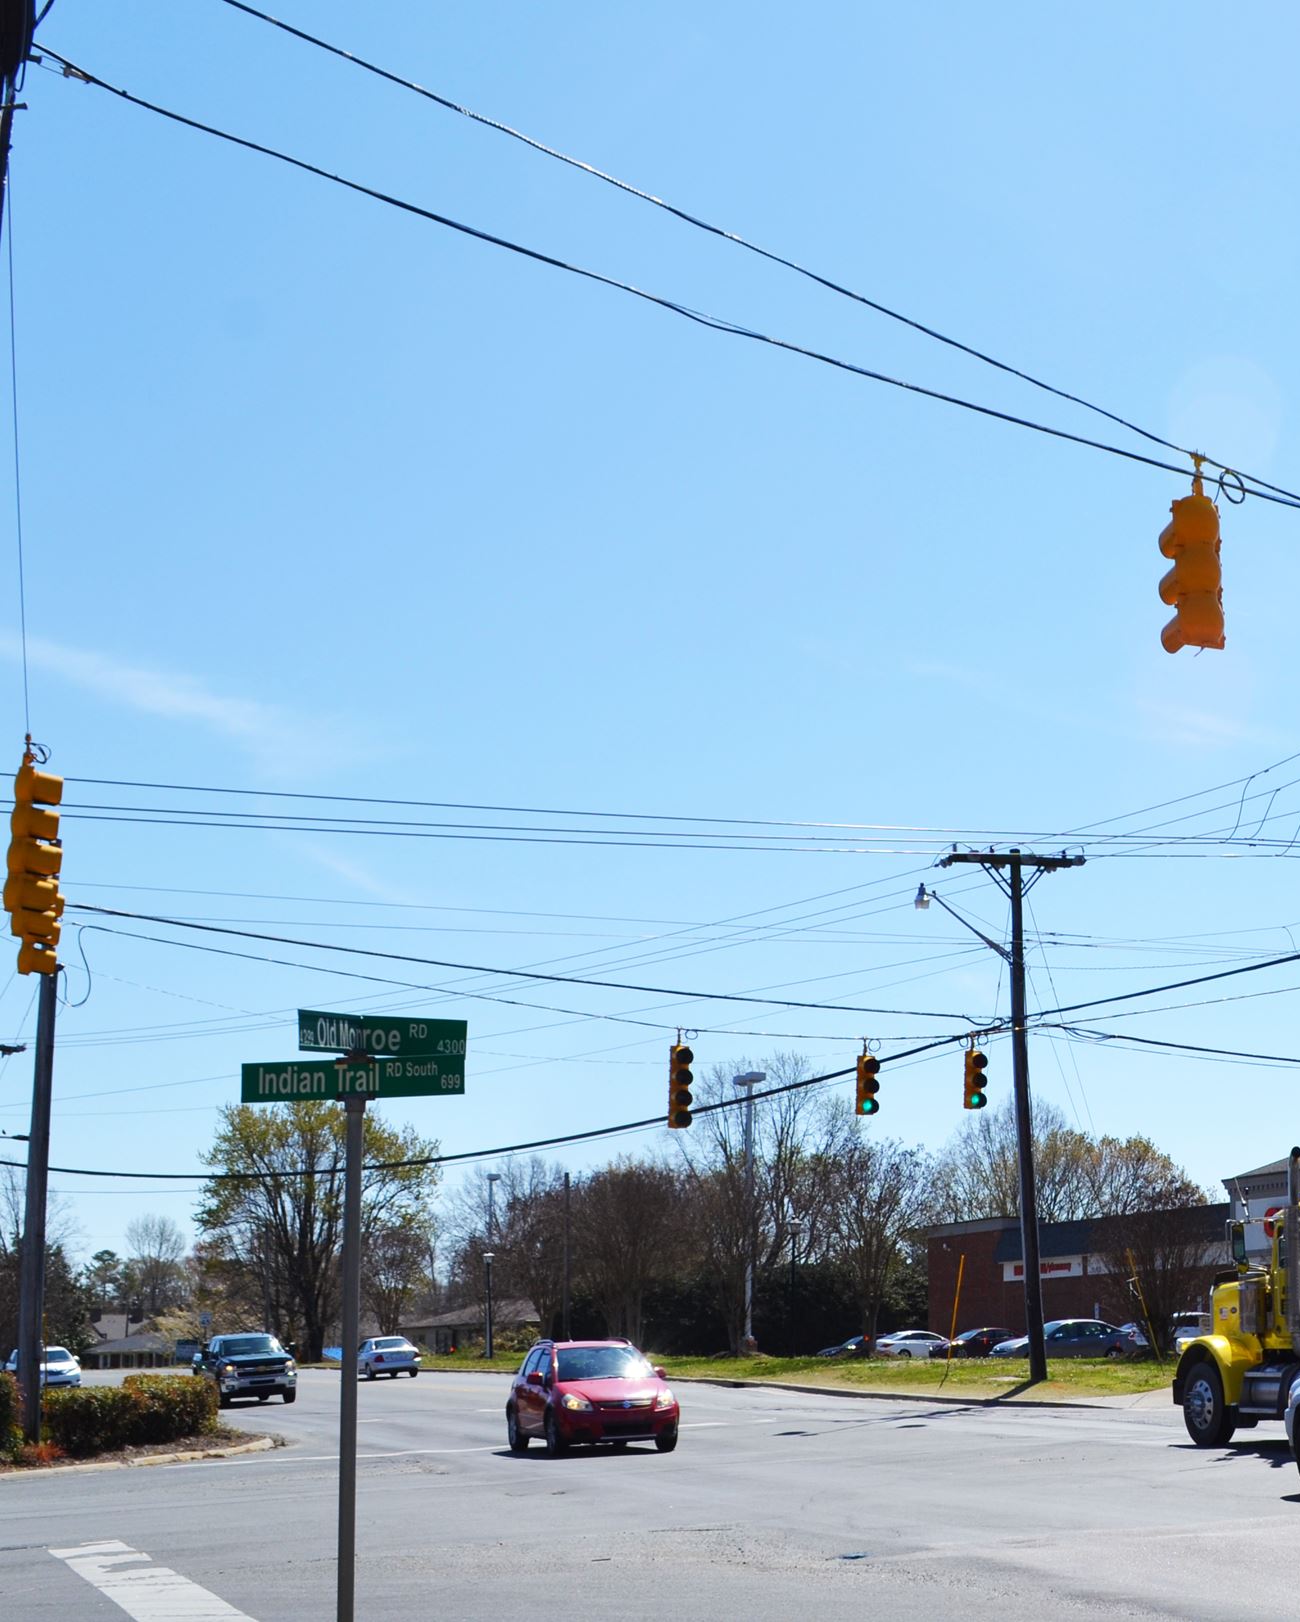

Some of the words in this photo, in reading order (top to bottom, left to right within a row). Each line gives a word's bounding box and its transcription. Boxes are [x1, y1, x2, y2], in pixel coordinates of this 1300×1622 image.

[317, 1017, 337, 1047] Old
[340, 1020, 401, 1051] Monroe
[409, 1023, 428, 1039] RD
[436, 1039, 467, 1055] 4300
[259, 1066, 326, 1095] Indian
[334, 1063, 379, 1093] Trail
[386, 1062, 403, 1078] RD
[405, 1061, 438, 1077] South
[441, 1074, 461, 1089] 699
